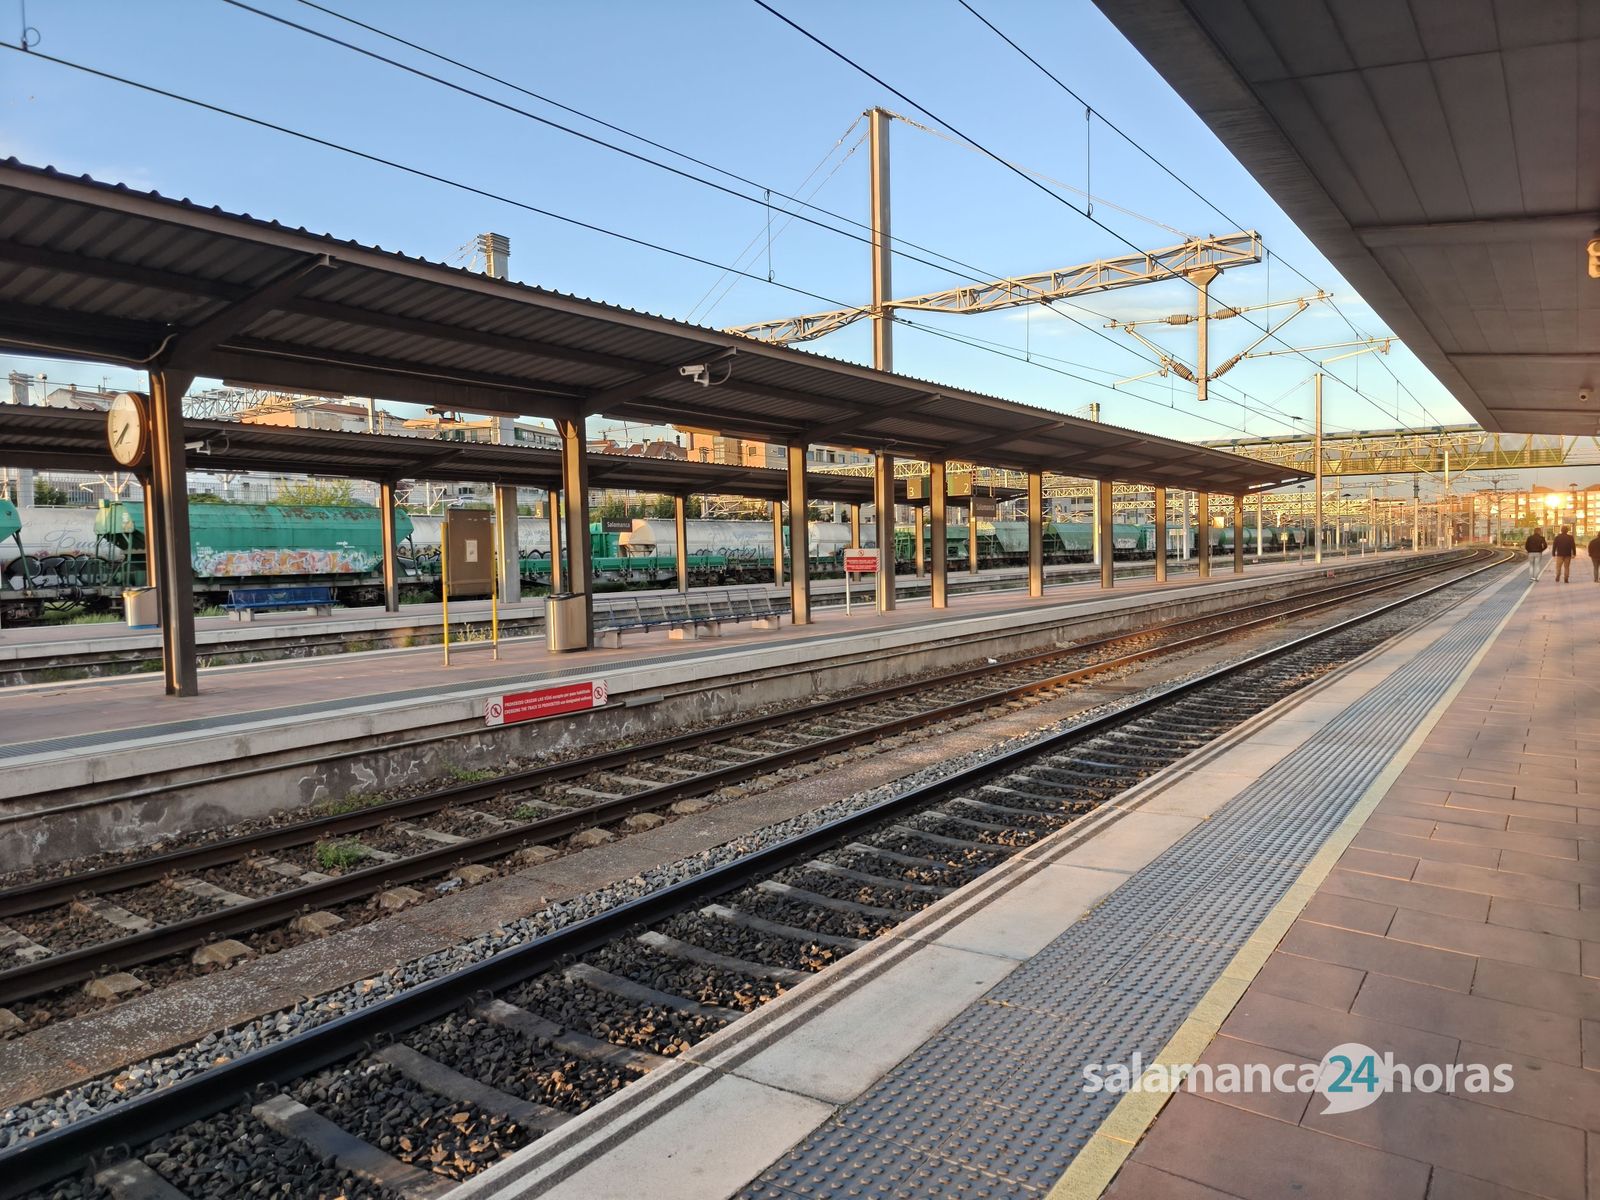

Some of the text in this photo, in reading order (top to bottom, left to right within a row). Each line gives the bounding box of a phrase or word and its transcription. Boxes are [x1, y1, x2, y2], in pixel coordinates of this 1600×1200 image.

[909, 487, 914, 497] 3
[964, 482, 969, 493] 2
[536, 509, 541, 517] 5
[606, 521, 631, 529] Salamanca
